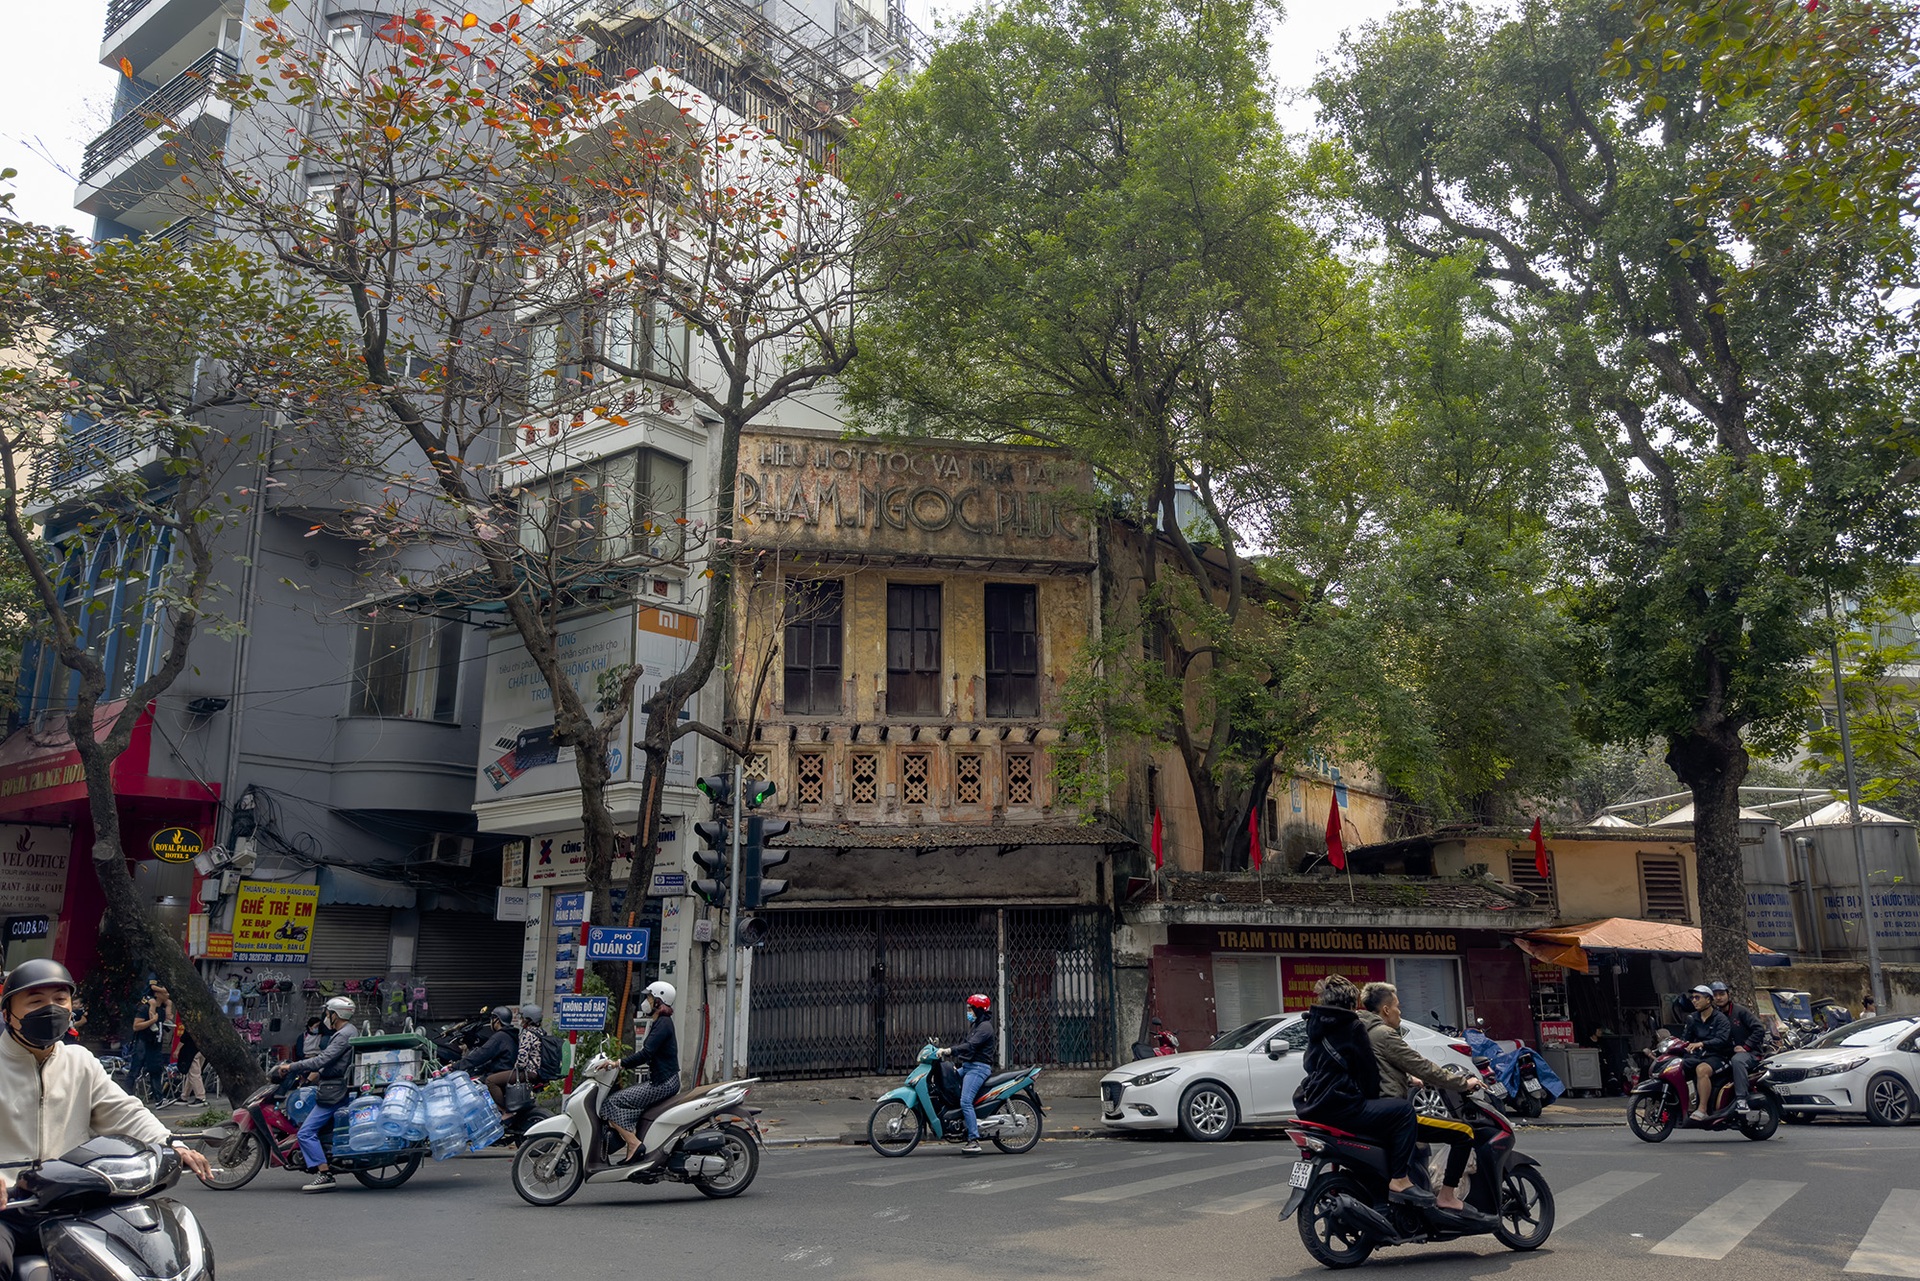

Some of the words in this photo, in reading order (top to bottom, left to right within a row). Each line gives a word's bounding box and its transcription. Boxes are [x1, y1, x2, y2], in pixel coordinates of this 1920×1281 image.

[562, 660, 589, 676] HÔNG
[532, 687, 552, 701] TRON
[155, 843, 175, 852] ROYAL
[177, 844, 200, 853] PALACE
[26, 853, 67, 869] OFFICE
[241, 895, 266, 915] GHẾ
[269, 895, 290, 916] TRẺ
[294, 902, 313, 917] EM
[504, 896, 524, 904] EPSON
[242, 918, 253, 927] XE
[239, 930, 249, 939] XE
[252, 929, 271, 939] MÁY
[614, 932, 633, 941] PHỐ
[1218, 931, 1265, 951] TRẠM
[1269, 932, 1295, 949] TIN
[1299, 929, 1363, 950] PHƯỜNG
[1367, 929, 1410, 950] HÀNG
[1415, 930, 1457, 951] BÔNG
[592, 940, 624, 955] QUÁN
[626, 941, 643, 955] SỨ
[562, 1000, 583, 1012] KHÔNG
[593, 1000, 605, 1012] RÁC
